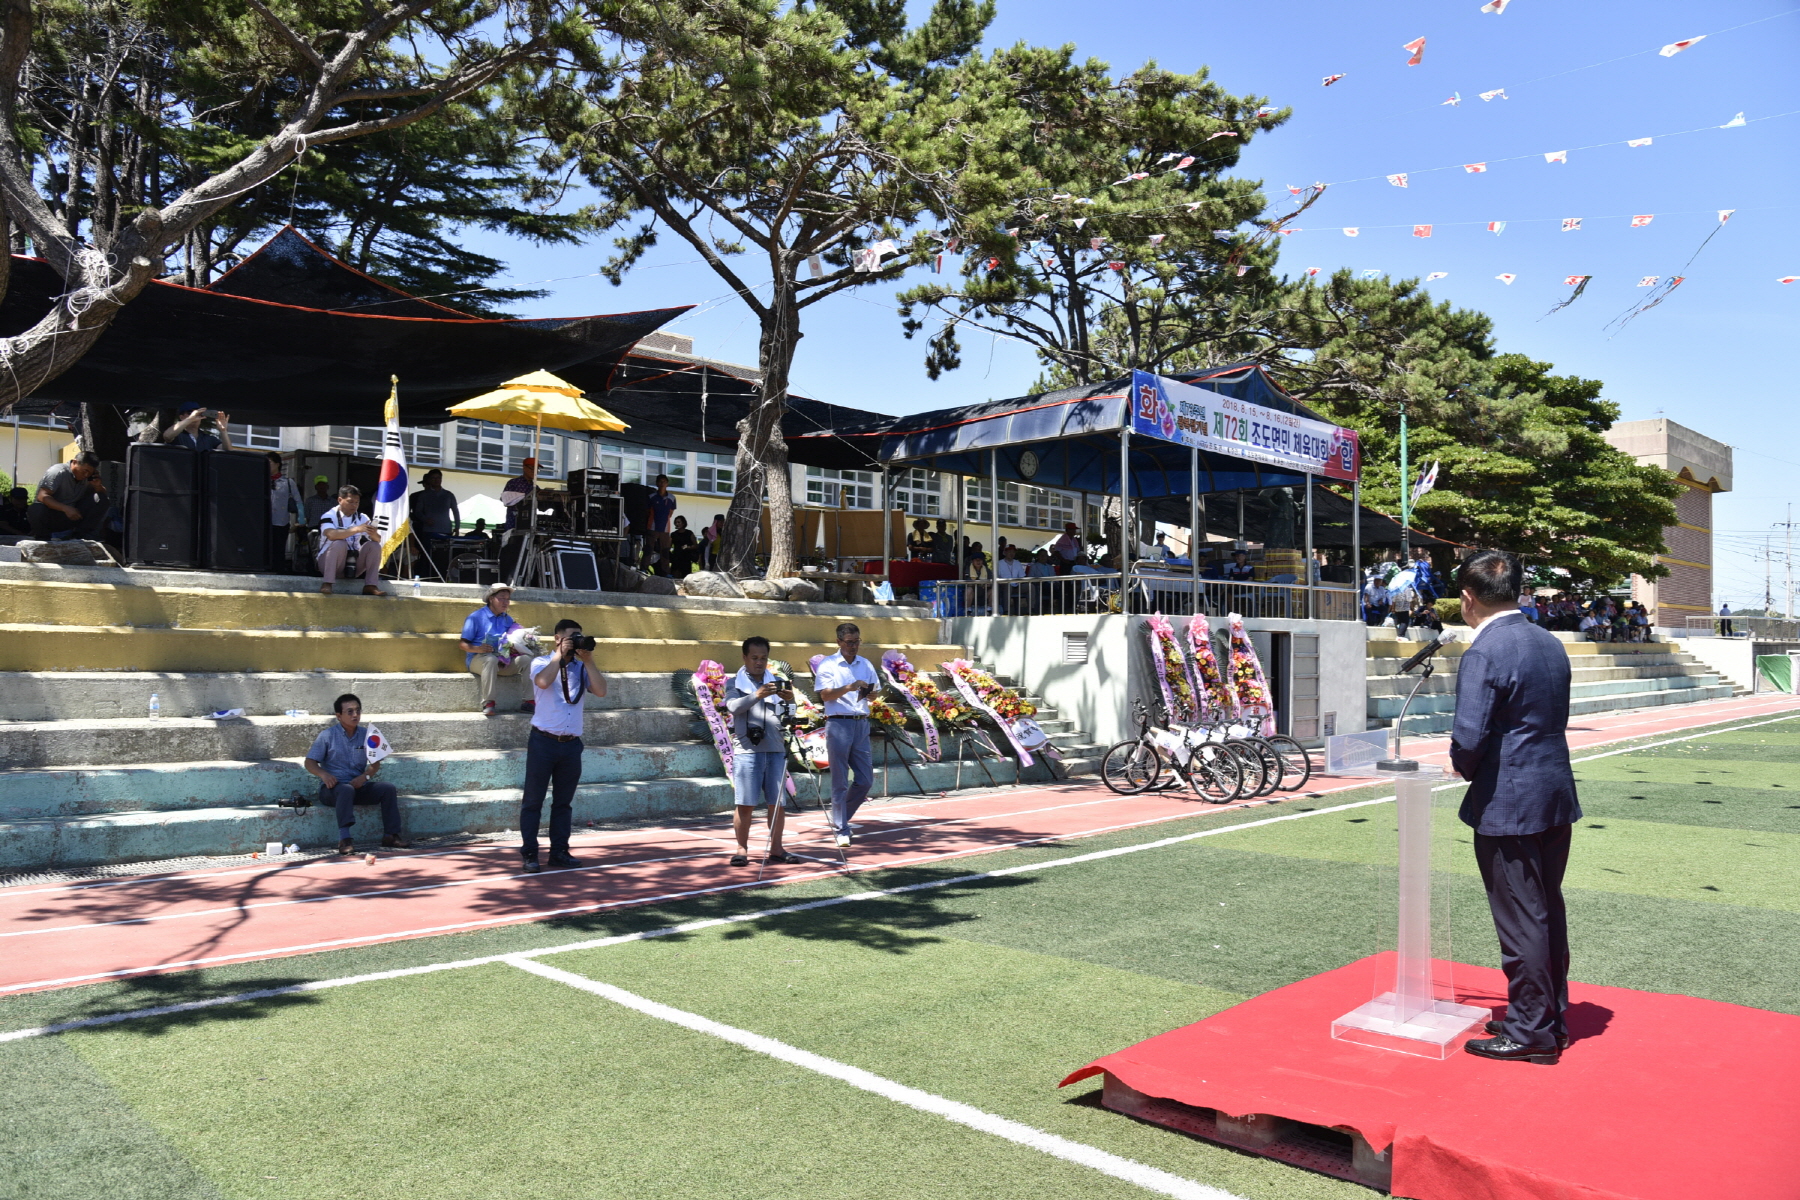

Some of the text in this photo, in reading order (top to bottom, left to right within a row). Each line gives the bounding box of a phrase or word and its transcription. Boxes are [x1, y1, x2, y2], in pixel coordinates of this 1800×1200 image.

[1140, 384, 1158, 424] 화
[1222, 398, 1240, 412] 2018.
[1213, 411, 1329, 462] 제72회 조도면민 체육대회
[1340, 439, 1354, 472] 합
